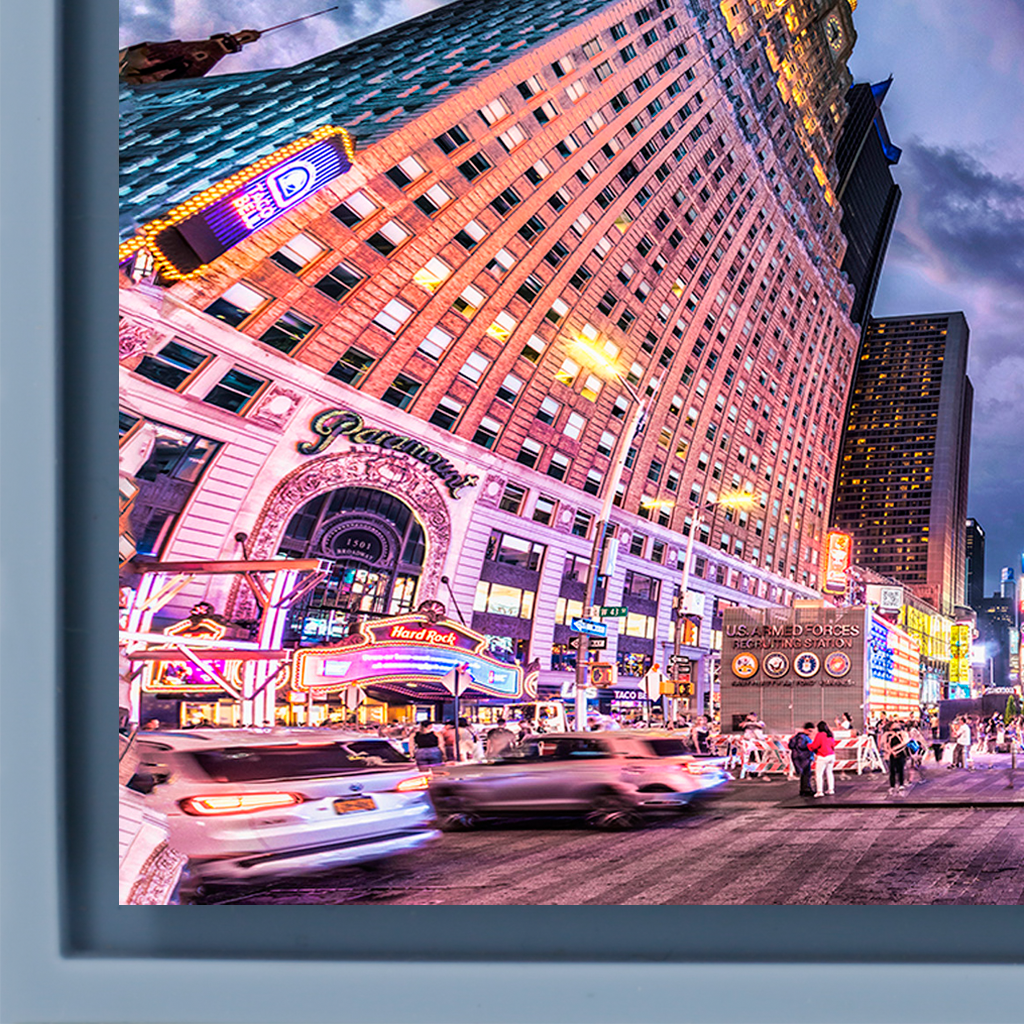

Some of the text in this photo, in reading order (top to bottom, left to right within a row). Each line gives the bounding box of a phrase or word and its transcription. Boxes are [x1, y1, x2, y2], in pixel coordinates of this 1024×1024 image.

[251, 182, 276, 220] TACO
[232, 195, 262, 230] BELL
[296, 408, 480, 501] Paramount
[347, 538, 372, 550] 1501
[390, 625, 457, 645] Hard Rock
[726, 624, 860, 637] U.S. ARMED FORCES
[732, 638, 853, 649] RECRUITING STATION
[613, 690, 637, 700] TACO
